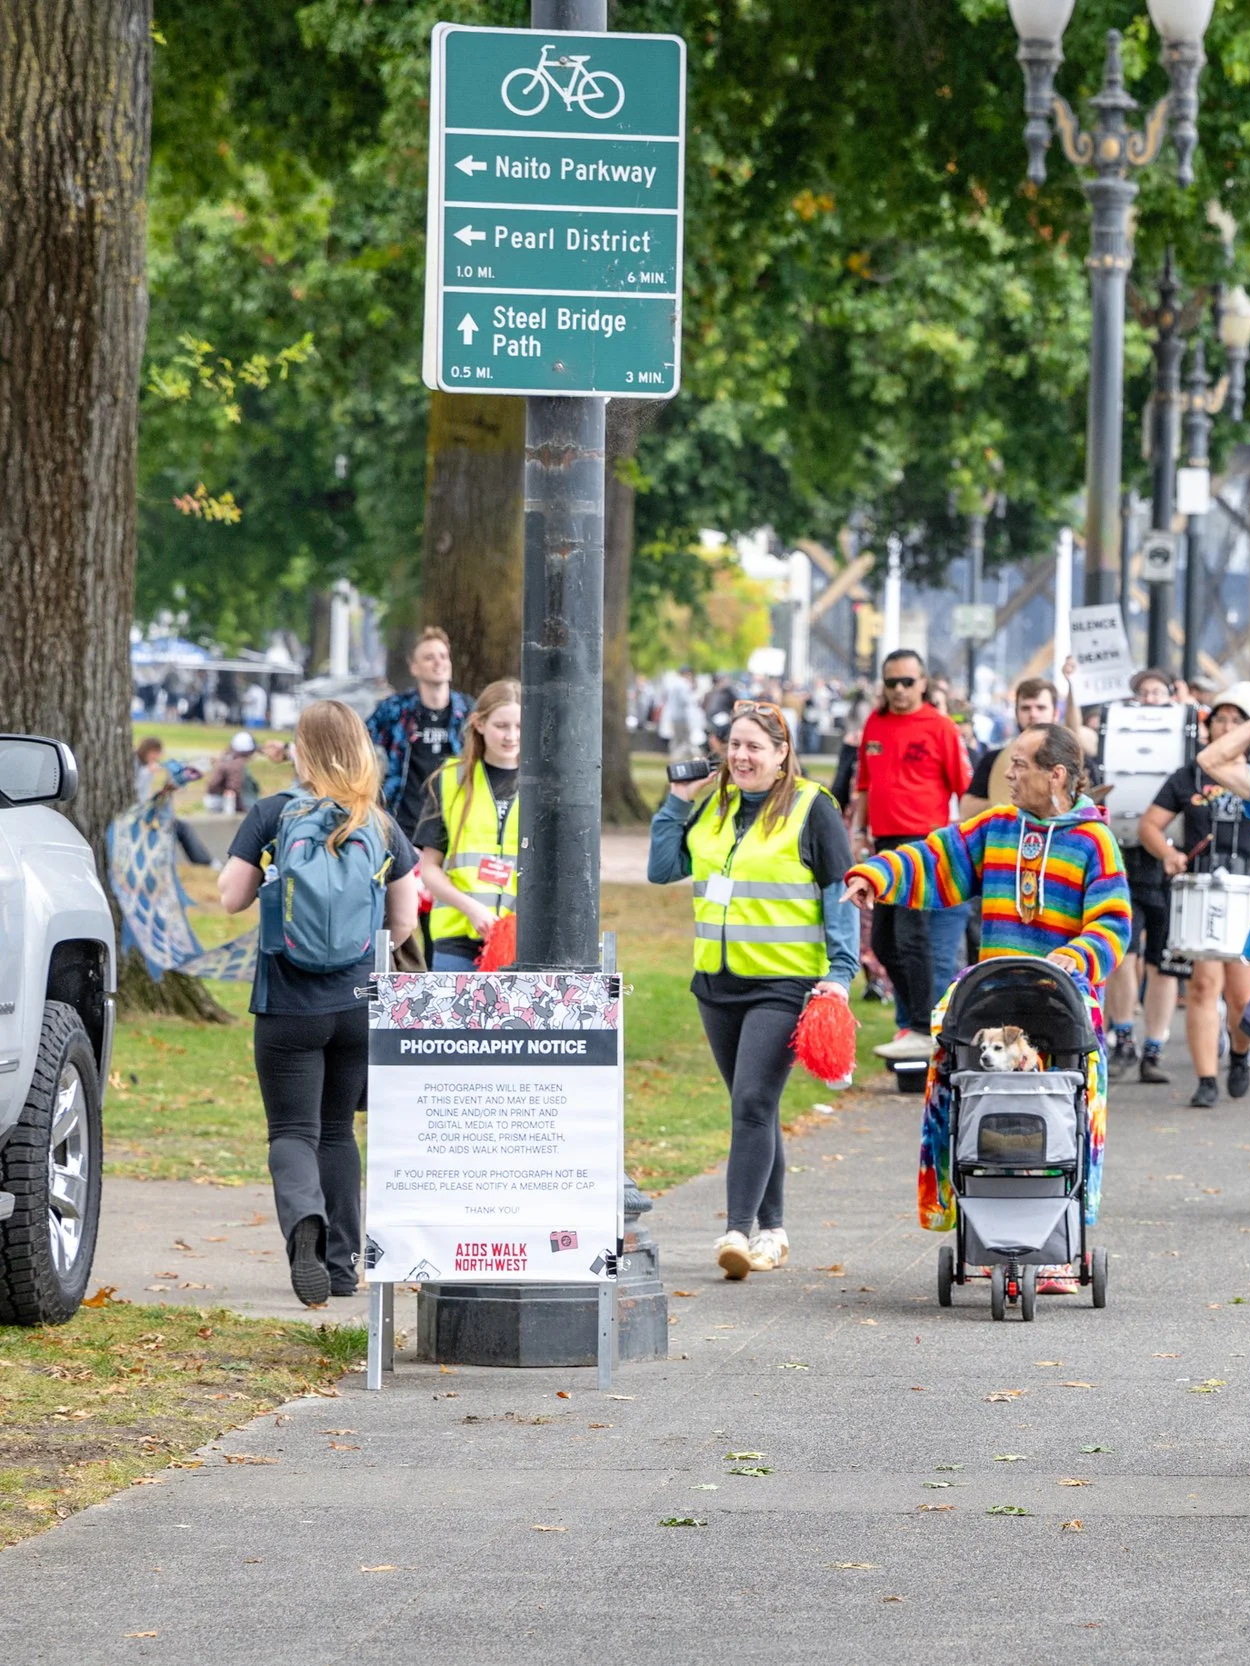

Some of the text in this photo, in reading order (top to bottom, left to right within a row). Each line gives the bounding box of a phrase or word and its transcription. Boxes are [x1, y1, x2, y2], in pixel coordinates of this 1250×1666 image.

[496, 155, 656, 188] Naito Parkway
[495, 226, 650, 253] Pearl District
[457, 266, 495, 278] 1.0 MI.
[627, 271, 667, 284] 6 MIN.
[493, 306, 626, 338] Steel Bridge
[493, 334, 541, 357] Path
[451, 366, 493, 379] 0.5 MI.
[626, 371, 664, 384] 3 MIN.
[1072, 617, 1117, 632] SILENCE
[400, 1039, 587, 1054] PHOTOGRAPHY NOTICE
[424, 1083, 563, 1092] PHOTOGRAPHS WILL BE TAKEN
[417, 1095, 567, 1105] AT THIS EVENT AND MAY BE USED
[426, 1108, 558, 1118] ONLINE AND/OR IN PRINT AND
[428, 1120, 555, 1129] DIGITAL MEDIA TO PROMOTE
[440, 1133, 460, 1142] OUR
[499, 1133, 527, 1142] PRISM
[427, 1145, 446, 1154] AND
[448, 1145, 469, 1154] AIDS
[472, 1145, 498, 1154] WALK
[394, 1169, 588, 1179] IF YOU PREFER YOUR PHOTOGRAPH NOT BE
[440, 1182, 473, 1191] PLEASE
[475, 1182, 508, 1191] NOTIFY
[511, 1182, 517, 1190] A
[520, 1182, 559, 1191] MEMBER
[561, 1181, 573, 1190] OF
[465, 1206, 495, 1214] THANK
[456, 1243, 527, 1257] AIDS WALK
[455, 1258, 527, 1271] NORTHWEST
